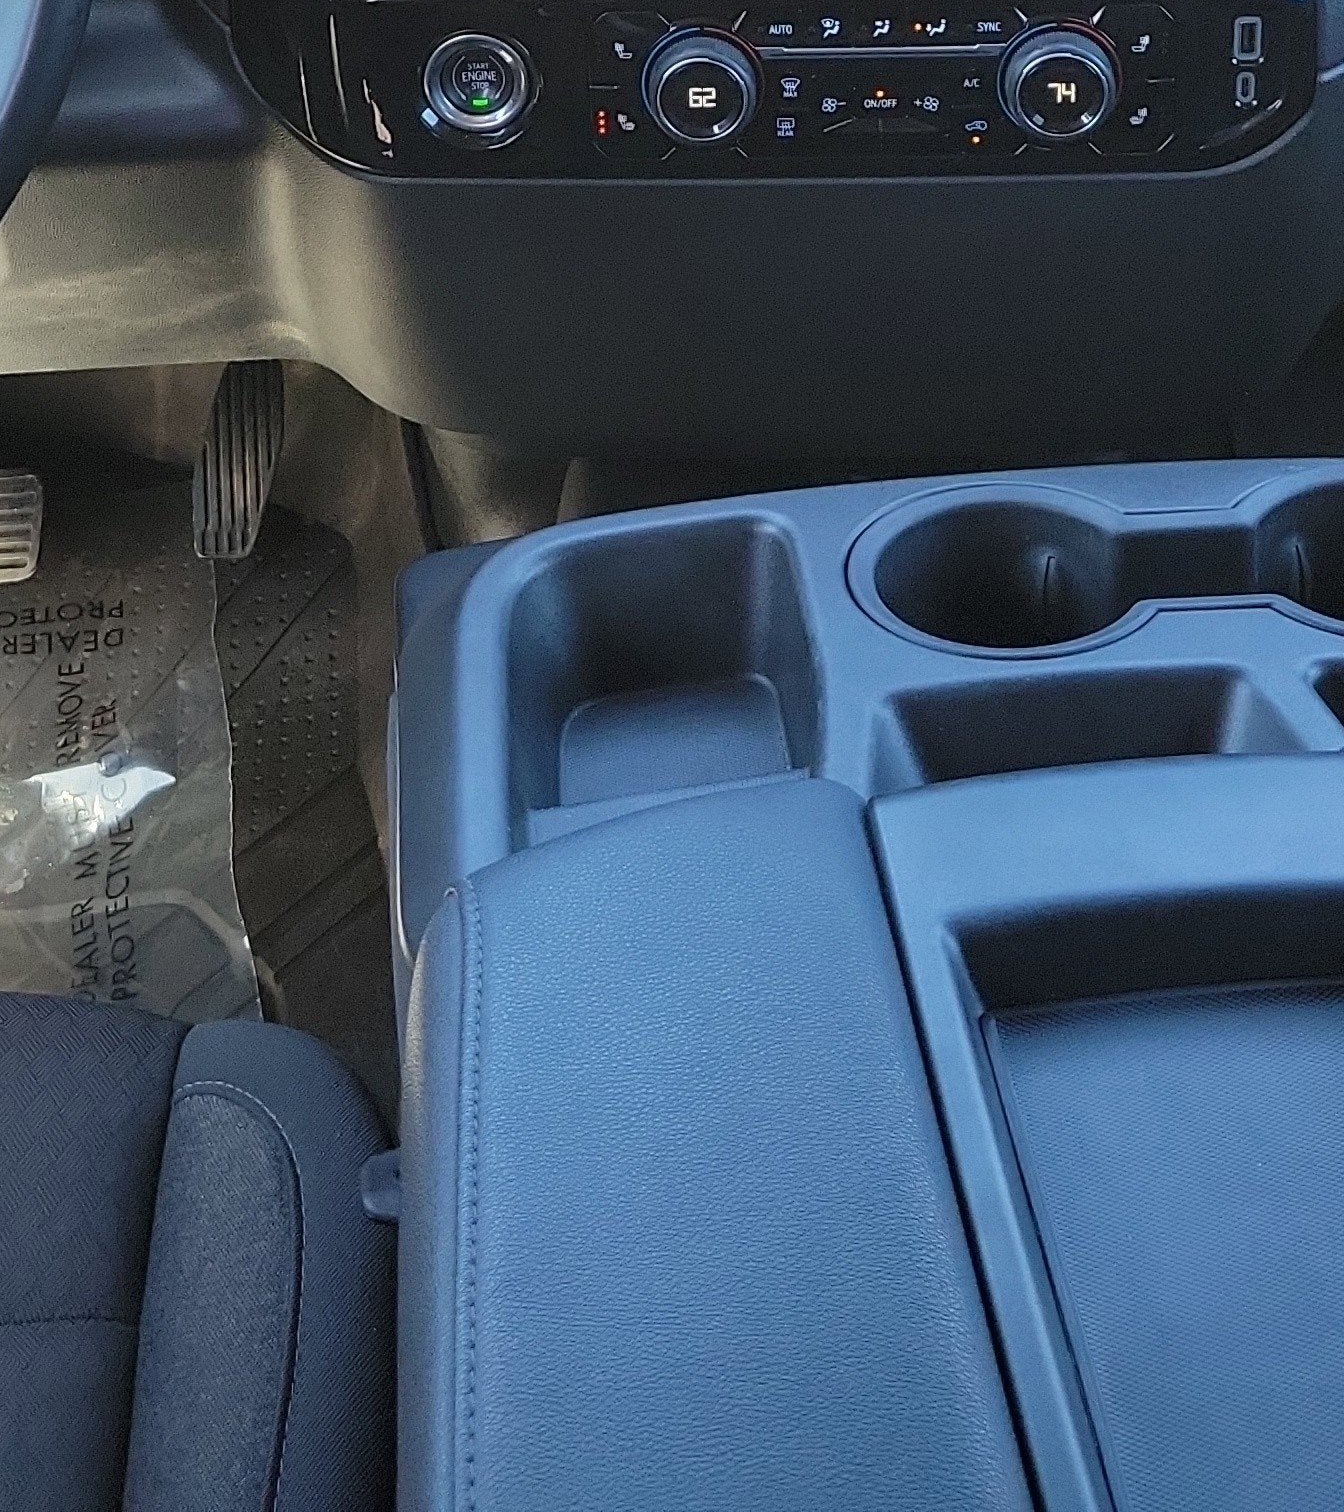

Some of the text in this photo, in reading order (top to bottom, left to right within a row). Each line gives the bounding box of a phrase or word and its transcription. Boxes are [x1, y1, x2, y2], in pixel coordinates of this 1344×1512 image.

[768, 24, 793, 35] AUTO
[976, 22, 1002, 33] SYNC
[467, 63, 489, 71] START
[461, 70, 497, 83] ENGINE
[471, 82, 490, 90] STOP
[963, 78, 981, 89] A/C
[688, 87, 717, 108] 62
[1047, 82, 1077, 104] 74
[863, 98, 898, 109] ON/OFF
[2, 628, 125, 656] DEALER
[55, 661, 85, 768] REMOVE
[105, 816, 137, 1002] PROTECTIVE
